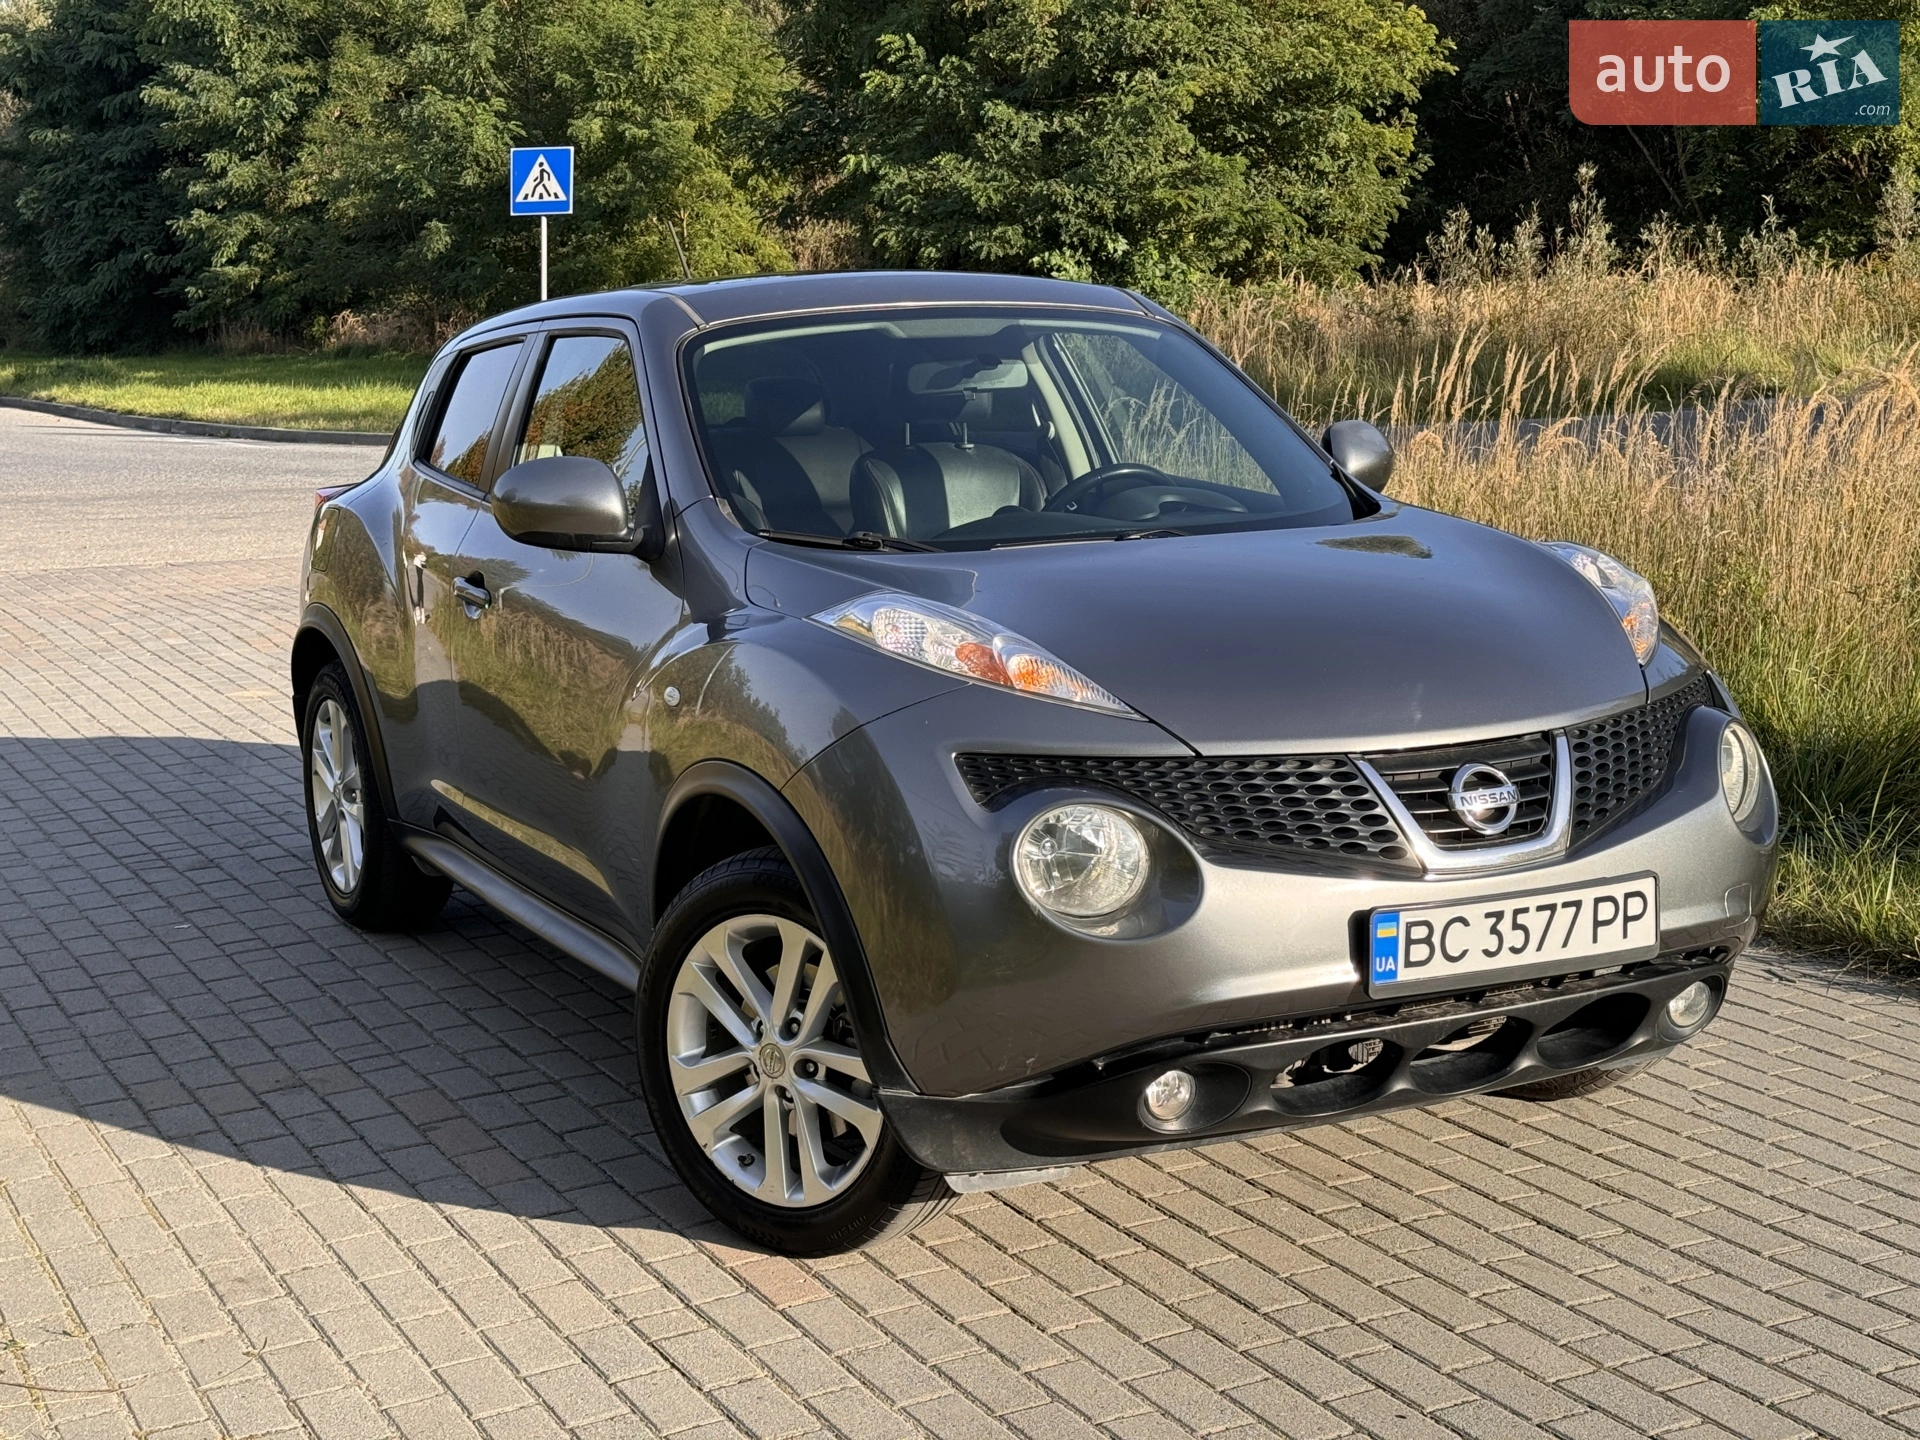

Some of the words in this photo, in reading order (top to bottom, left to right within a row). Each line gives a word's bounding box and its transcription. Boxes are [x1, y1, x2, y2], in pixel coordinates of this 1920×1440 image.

[1460, 789, 1517, 807] NISSAN
[1403, 915, 1471, 969] BC
[1481, 899, 1583, 958] 3577
[1592, 890, 1648, 944] PP
[1376, 956, 1396, 972] UA
